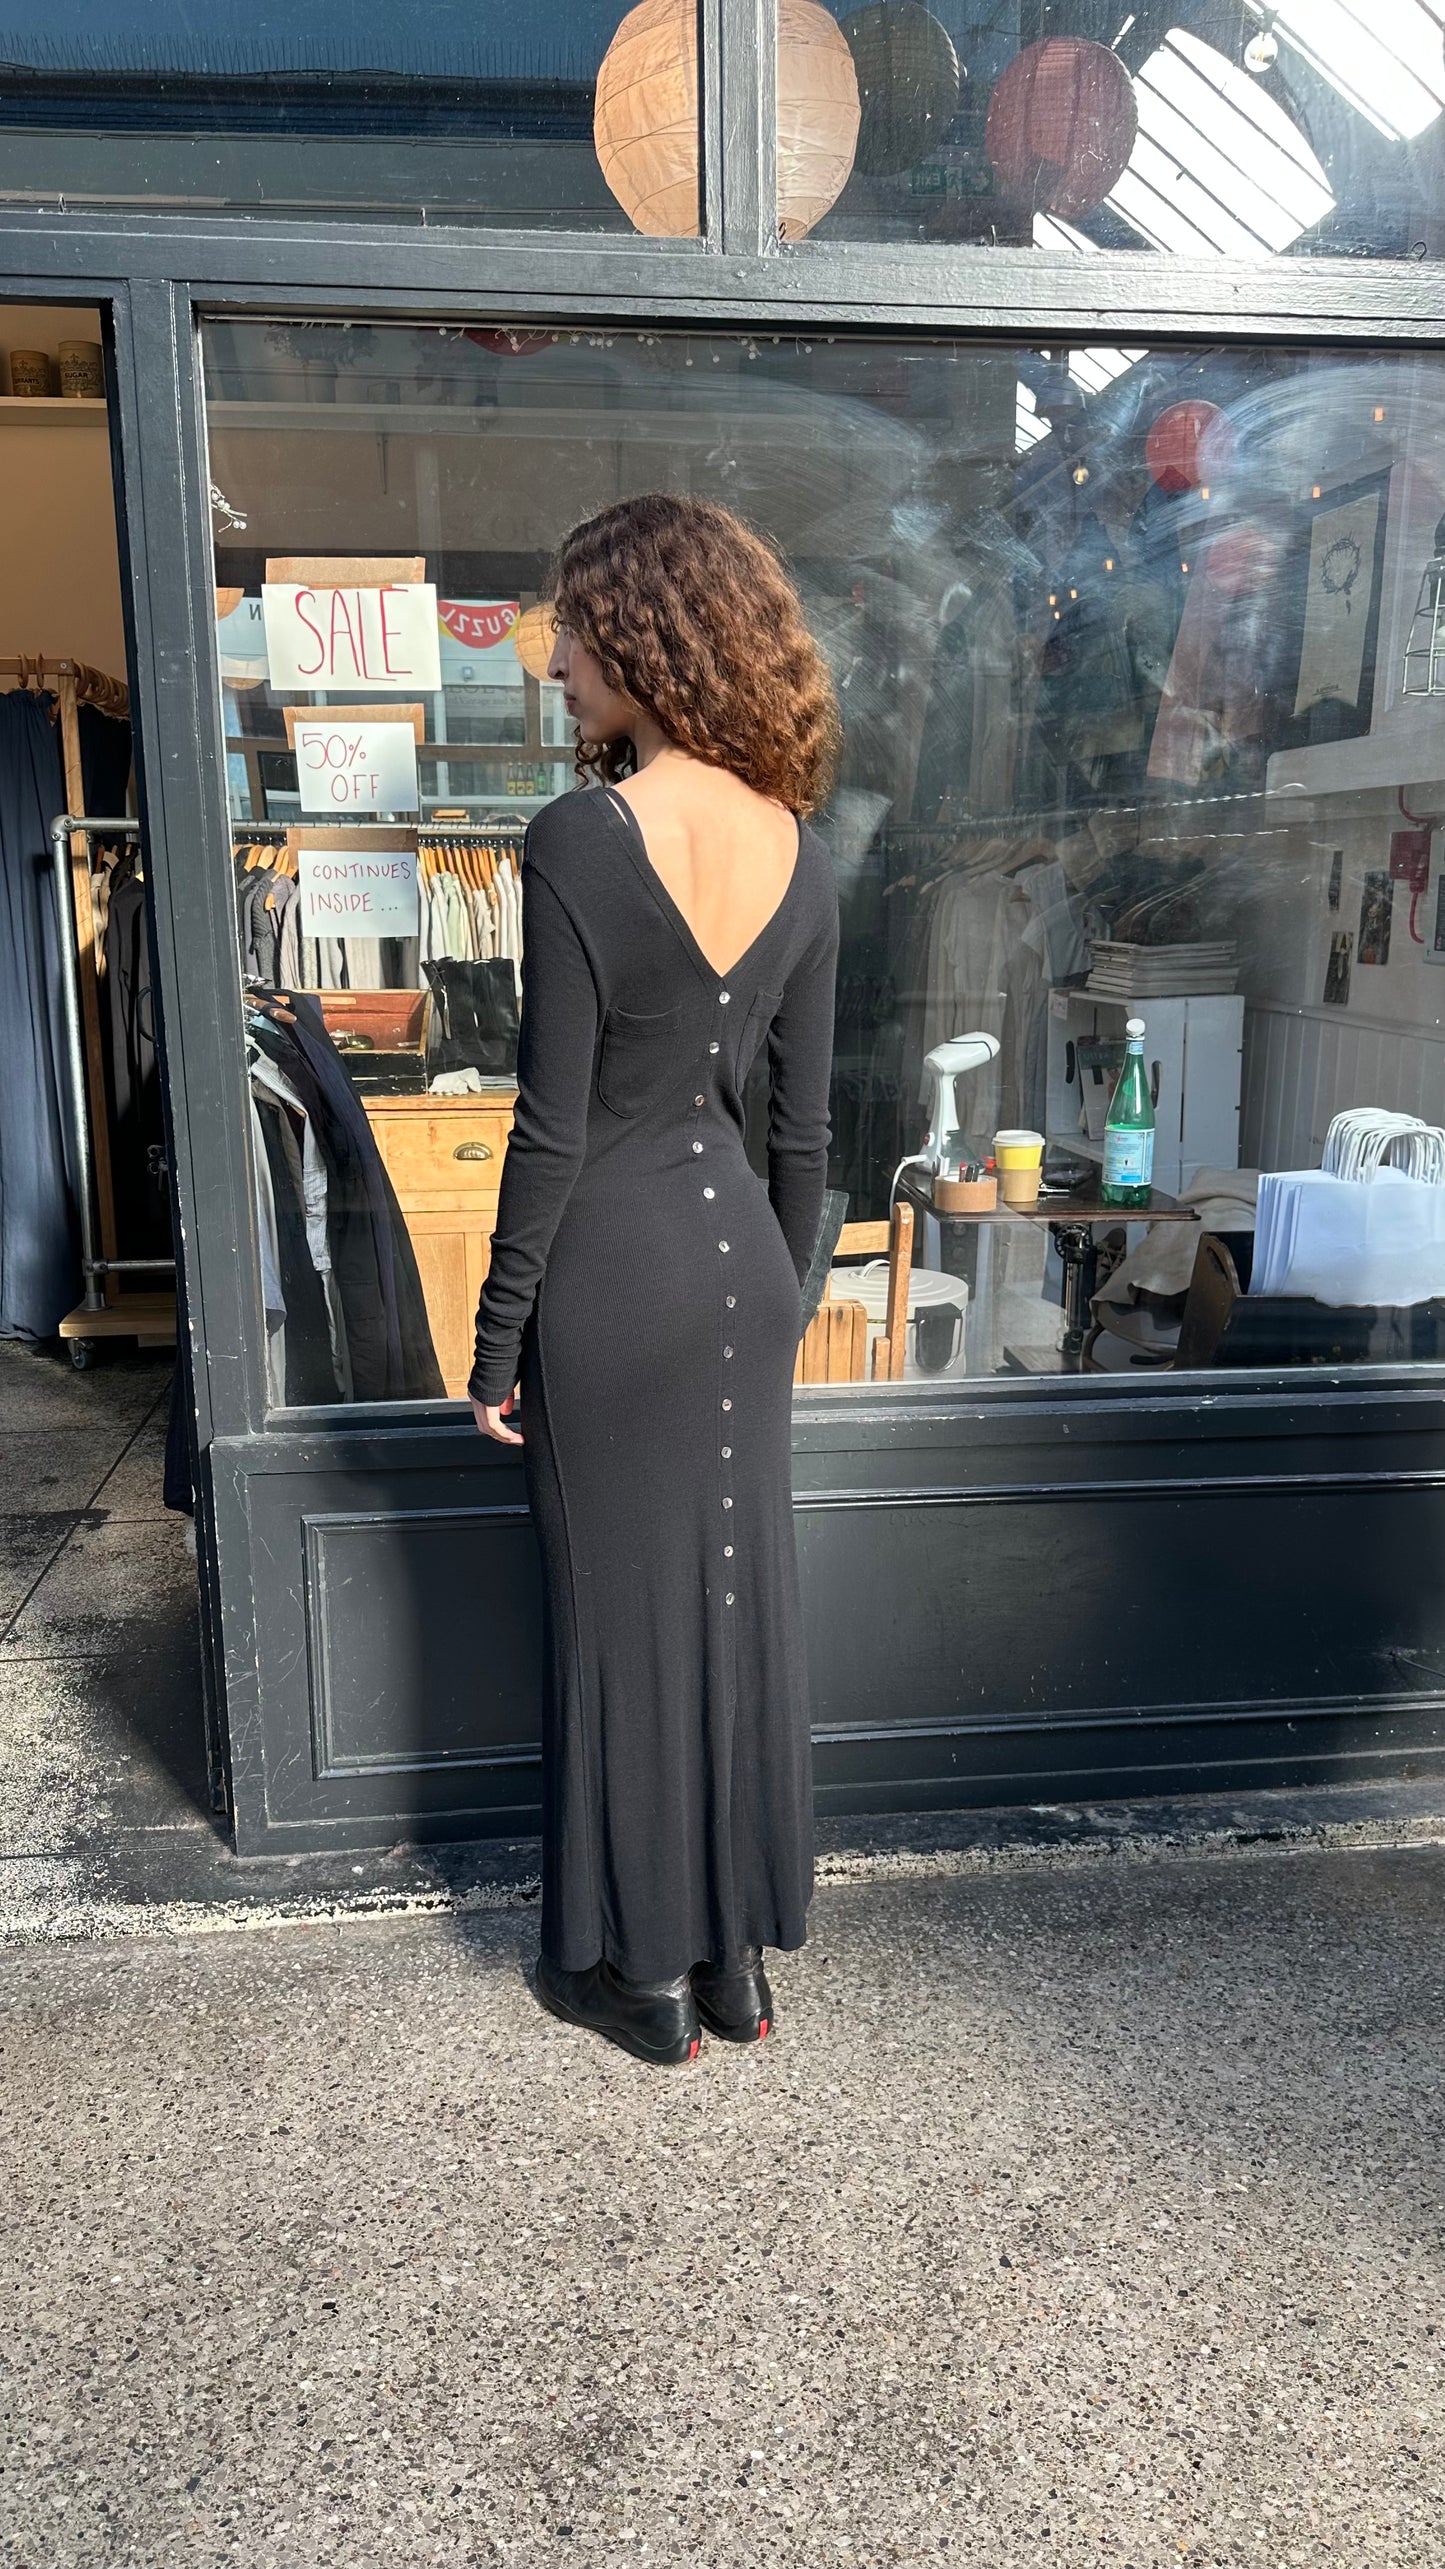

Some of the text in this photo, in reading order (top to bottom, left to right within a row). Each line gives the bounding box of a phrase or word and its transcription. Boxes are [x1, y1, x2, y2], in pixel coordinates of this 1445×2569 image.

[294, 588, 412, 681] SALE
[302, 733, 366, 769] 50%
[331, 774, 379, 802] OFF
[312, 861, 411, 880] CONTINUES
